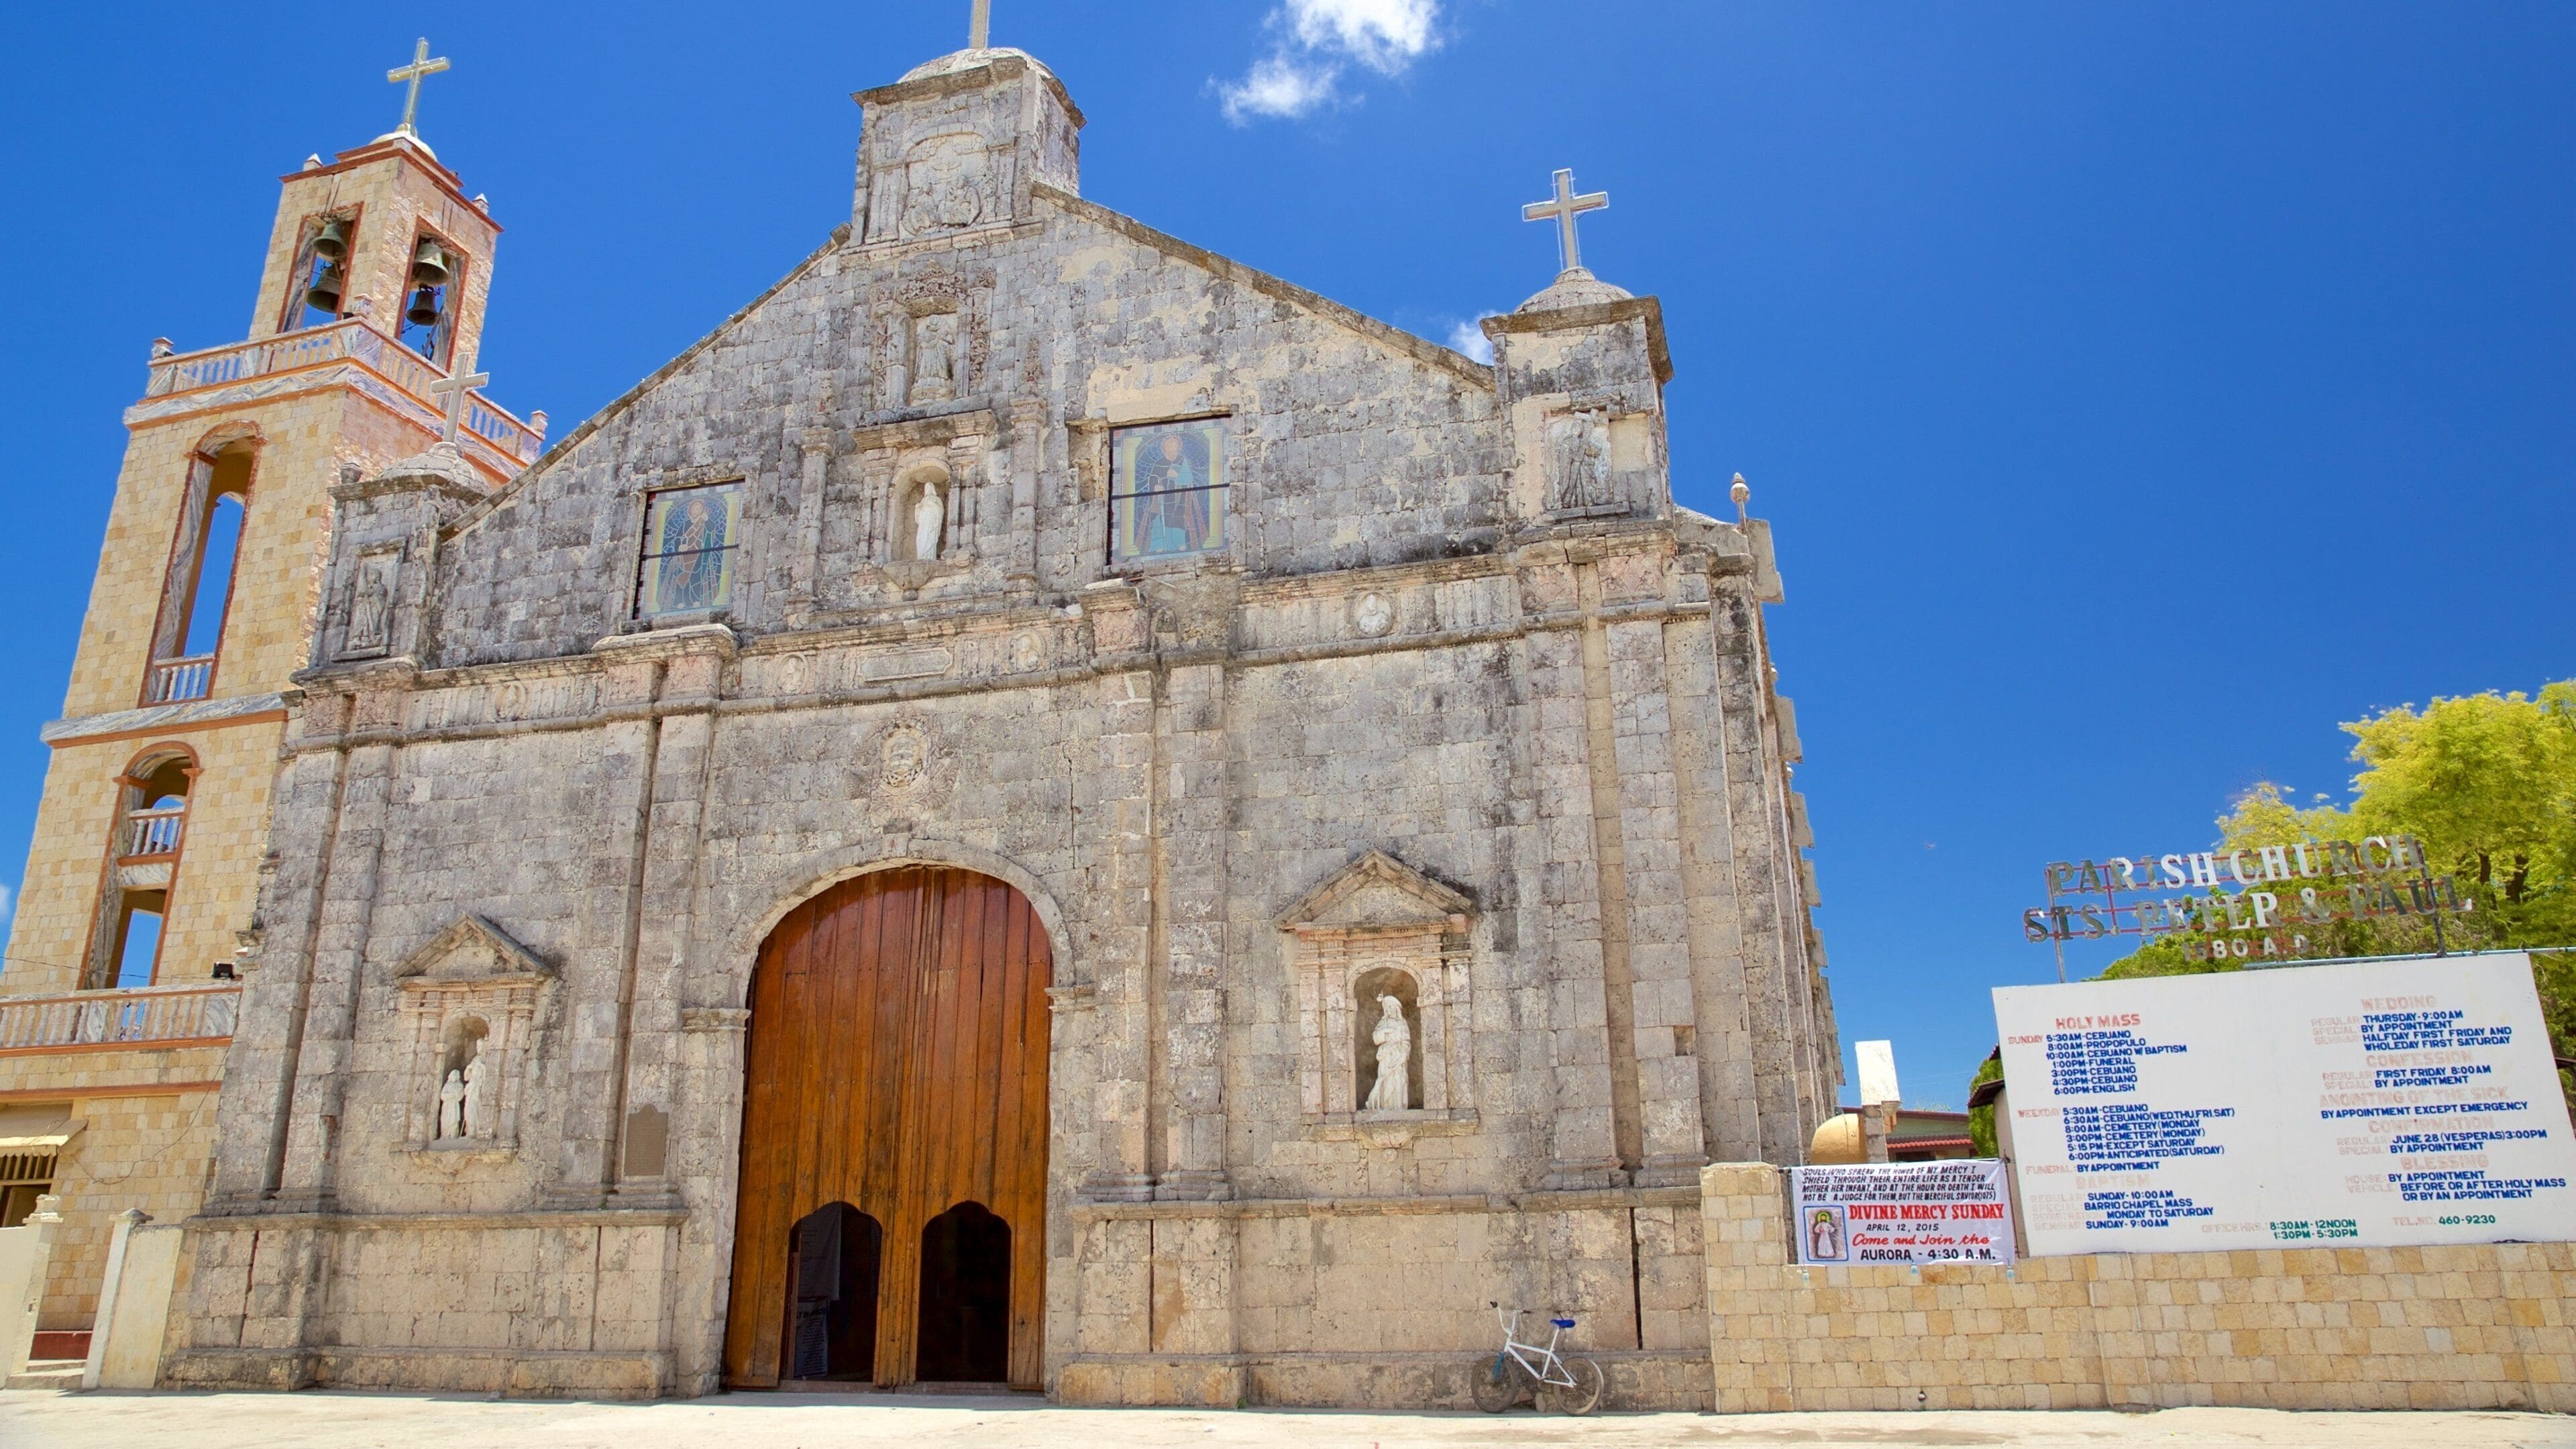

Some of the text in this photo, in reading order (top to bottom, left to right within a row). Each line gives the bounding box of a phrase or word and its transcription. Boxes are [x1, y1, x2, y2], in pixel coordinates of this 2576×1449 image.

[2049, 833, 2426, 897] PARISH CHURCH
[2023, 875, 2473, 943] STS. PETER & PAUL
[2181, 937, 2248, 961] 1580
[2360, 995, 2437, 1011] WEDDING
[2055, 1014, 2141, 1030] HOLY MASS
[2361, 1024, 2374, 1033] BY
[2378, 1020, 2453, 1032] APPOINTMENT
[2008, 1034, 2043, 1044] SUNDAY
[2363, 1032, 2410, 1042] HALFDAY
[2414, 1030, 2444, 1040] FIRST
[2449, 1028, 2485, 1038] FRIDAY
[2489, 1026, 2512, 1035] AND
[2145, 1044, 2188, 1055] BAPTISM
[2365, 1036, 2510, 1051] WHOLEDAY FIRST SATURDAY
[2365, 1051, 2474, 1067] CONFESSION
[2376, 1069, 2407, 1079] FIRST
[2410, 1067, 2446, 1077] FRIDAY
[2375, 1079, 2387, 1088] BY
[2393, 1075, 2469, 1087] APPOINTMENT
[2320, 1090, 2404, 1107] ANOINTING
[2434, 1087, 2467, 1102] THE
[2470, 1085, 2511, 1101] SICK
[2017, 1107, 2060, 1118] WEEKDAY
[2321, 1101, 2528, 1119] BY APPOINTMENT EXCEPT EMERGENCY
[2368, 1115, 2495, 1134] CONFIRMATION
[2147, 1138, 2196, 1148] SATURDAY
[2392, 1134, 2422, 1144] JUNE
[2424, 1133, 2440, 1142] 28
[2390, 1144, 2405, 1154] BY
[2407, 1141, 2483, 1153] APPOINTMENT
[2077, 1164, 2090, 1173] BY
[2091, 1161, 2159, 1172] APPOINTMENT
[2400, 1154, 2489, 1171] BLESSING
[1927, 1166, 1938, 1174] MY
[1941, 1165, 1968, 1174] MERCY
[2388, 1173, 2402, 1182] BY
[2407, 1170, 2485, 1181] APPOINTMENT
[1893, 1175, 1920, 1183] ENTIRE
[1958, 1174, 1986, 1182] TENDER
[2075, 1175, 2150, 1189] BAPTISM
[2400, 1182, 2446, 1191] BEFORE
[2448, 1181, 2465, 1190] OR
[2466, 1179, 2505, 1189] AFTER
[2505, 1179, 2534, 1188] HOLY
[2535, 1177, 2566, 1187] MASS
[1802, 1184, 1829, 1193] MOTHER
[1831, 1184, 1843, 1192] HER
[1873, 1183, 1887, 1191] AND
[1889, 1183, 1898, 1191] AT
[1901, 1183, 1915, 1191] THE
[1917, 1183, 1935, 1191] HOUR
[1971, 1183, 1976, 1191] I
[1977, 1183, 1994, 1191] WILL
[2403, 1188, 2532, 1201] OR BY AN APPOINTMENT
[1865, 1193, 1876, 1201] FOR
[1913, 1193, 1923, 1201] THE
[1924, 1193, 1954, 1201] MERCIFUL
[2084, 1201, 2121, 1211] BARRIO
[2122, 1199, 2163, 1210] CHAPEL
[2165, 1198, 2192, 1208] MASS
[1848, 1203, 2004, 1220] DIVINE MERCY SUNDAY
[2106, 1210, 2145, 1219] MONDAY
[2150, 1208, 2163, 1218] TO
[2164, 1207, 2214, 1217] SATURDAY
[2438, 1214, 2496, 1225] 460-9230
[1866, 1224, 1890, 1232] APRIL
[1916, 1223, 1939, 1232] 2015
[1852, 1233, 1990, 1246] Come and Join the
[1860, 1249, 1912, 1261] AURORA
[1927, 1248, 1960, 1260] 4:30
[1965, 1248, 1996, 1260] A.M.
